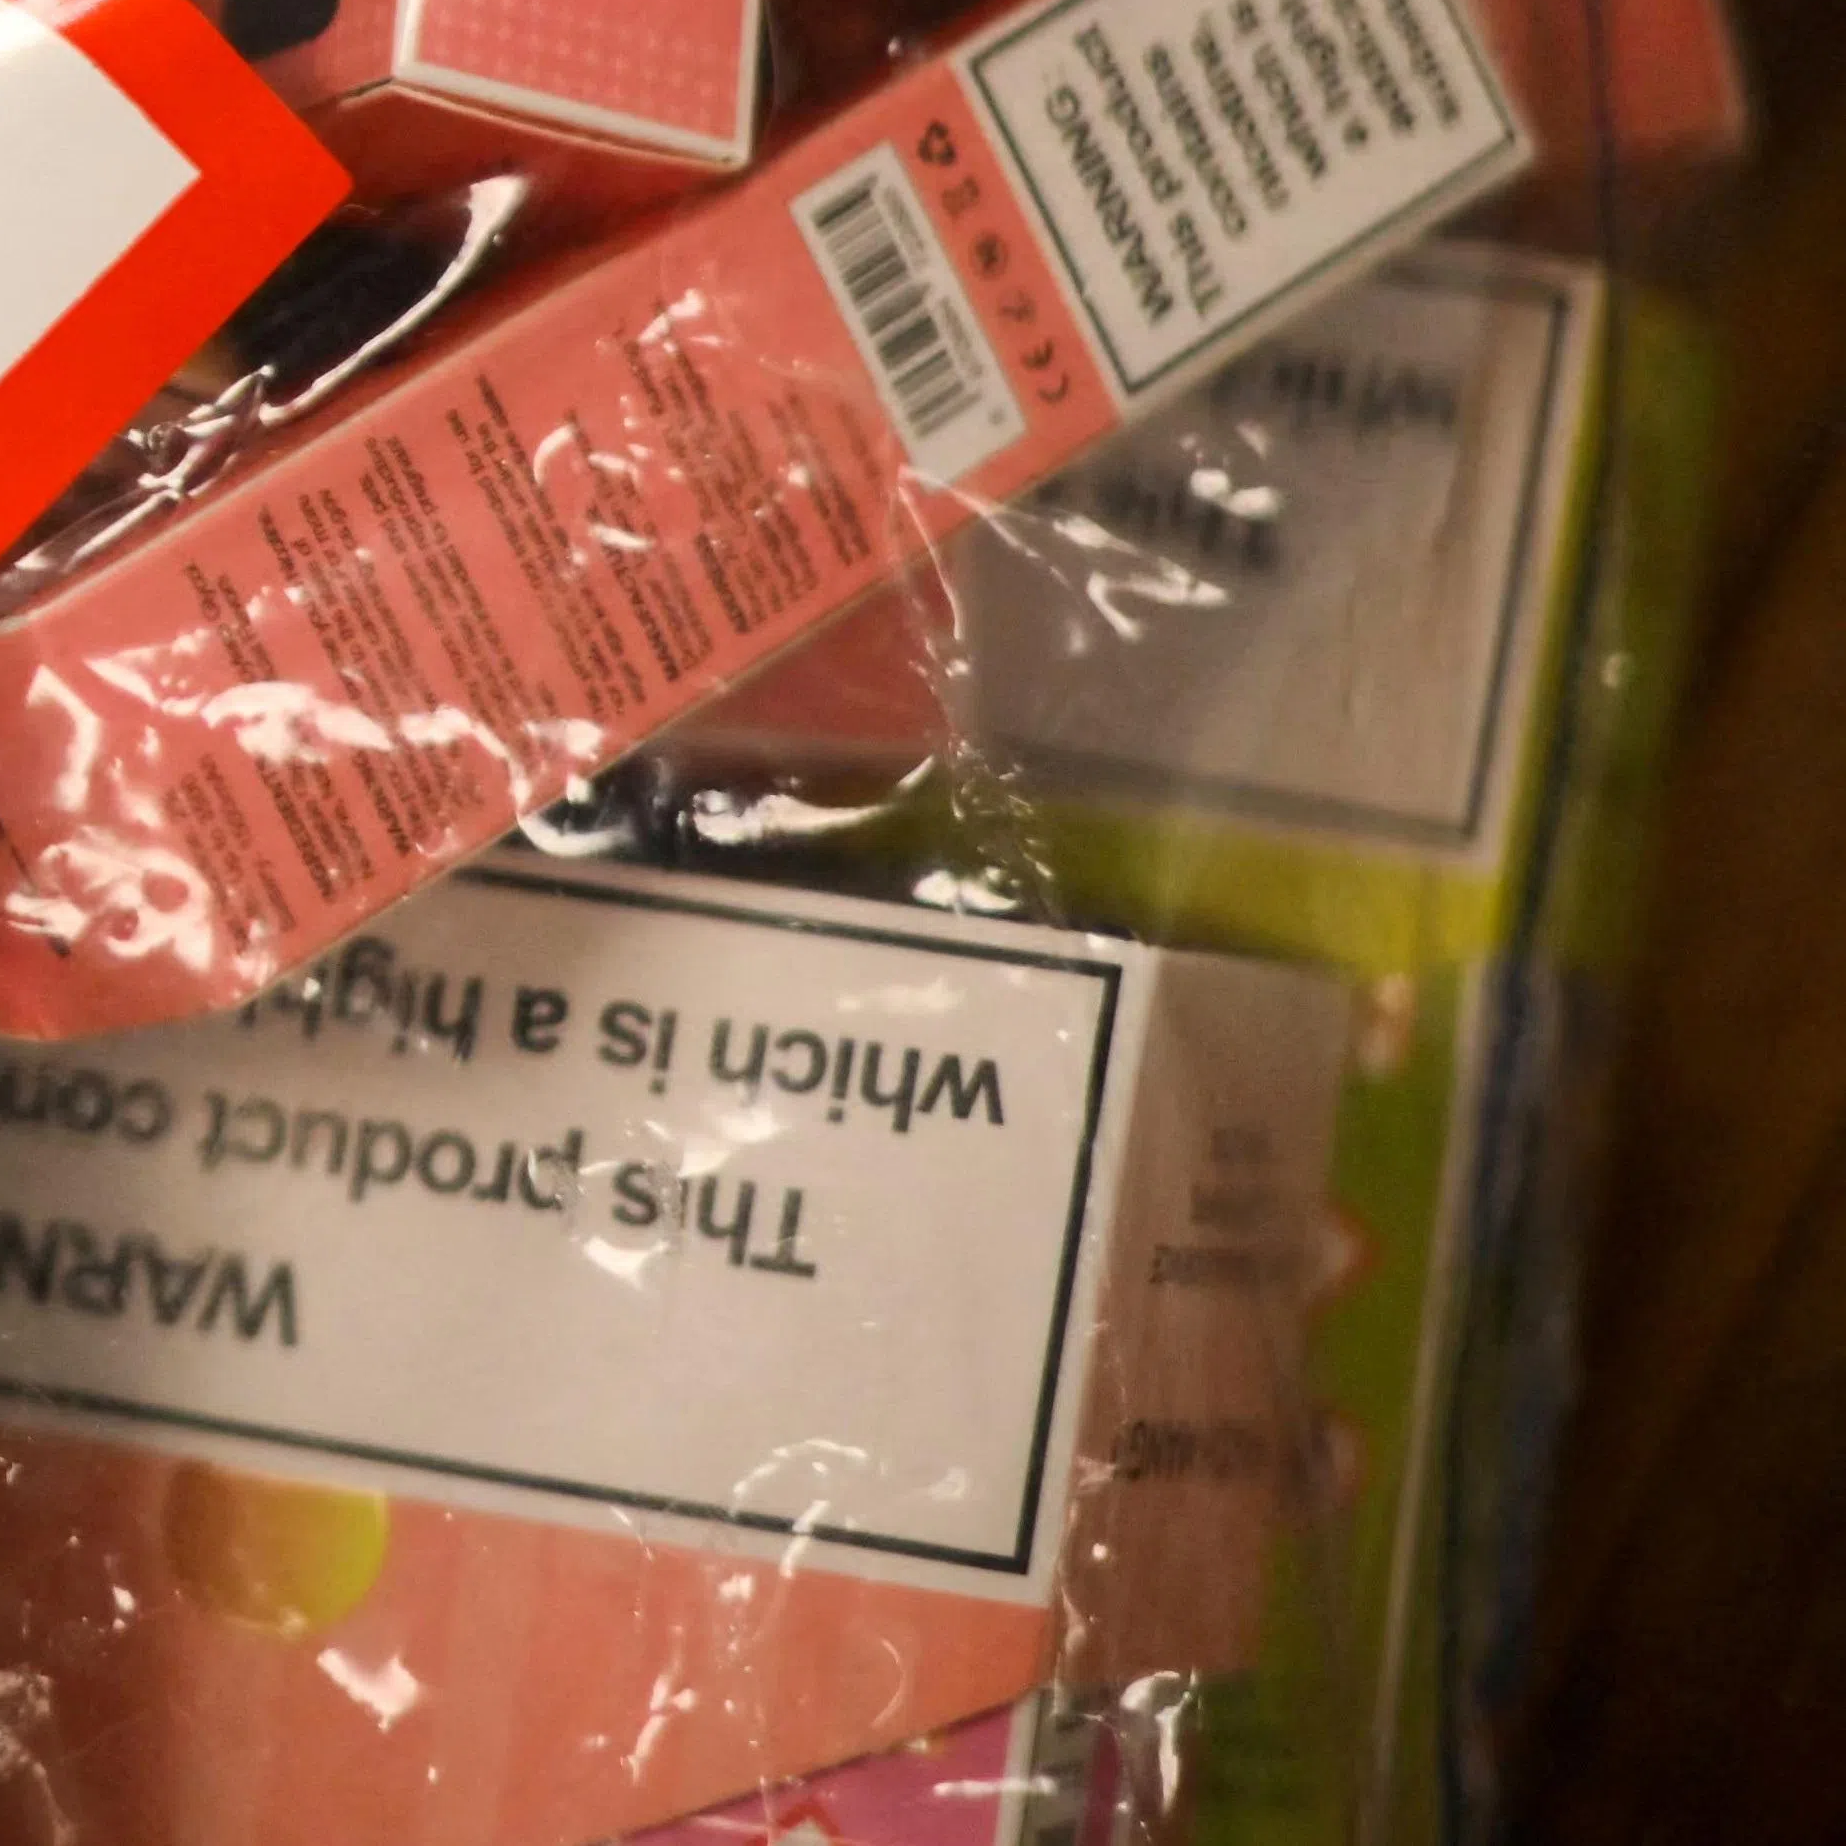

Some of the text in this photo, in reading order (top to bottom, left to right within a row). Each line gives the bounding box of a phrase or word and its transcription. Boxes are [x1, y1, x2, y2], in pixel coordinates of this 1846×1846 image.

[1072, 19, 1228, 320] This product
[1143, 42, 1248, 240] contains
[1251, 44, 1328, 182] which
[1342, 114, 1369, 149] a
[512, 983, 569, 1054] a
[596, 999, 679, 1096] is
[706, 1014, 1007, 1136] which
[199, 1089, 585, 1214] product
[611, 1158, 818, 1280] This
